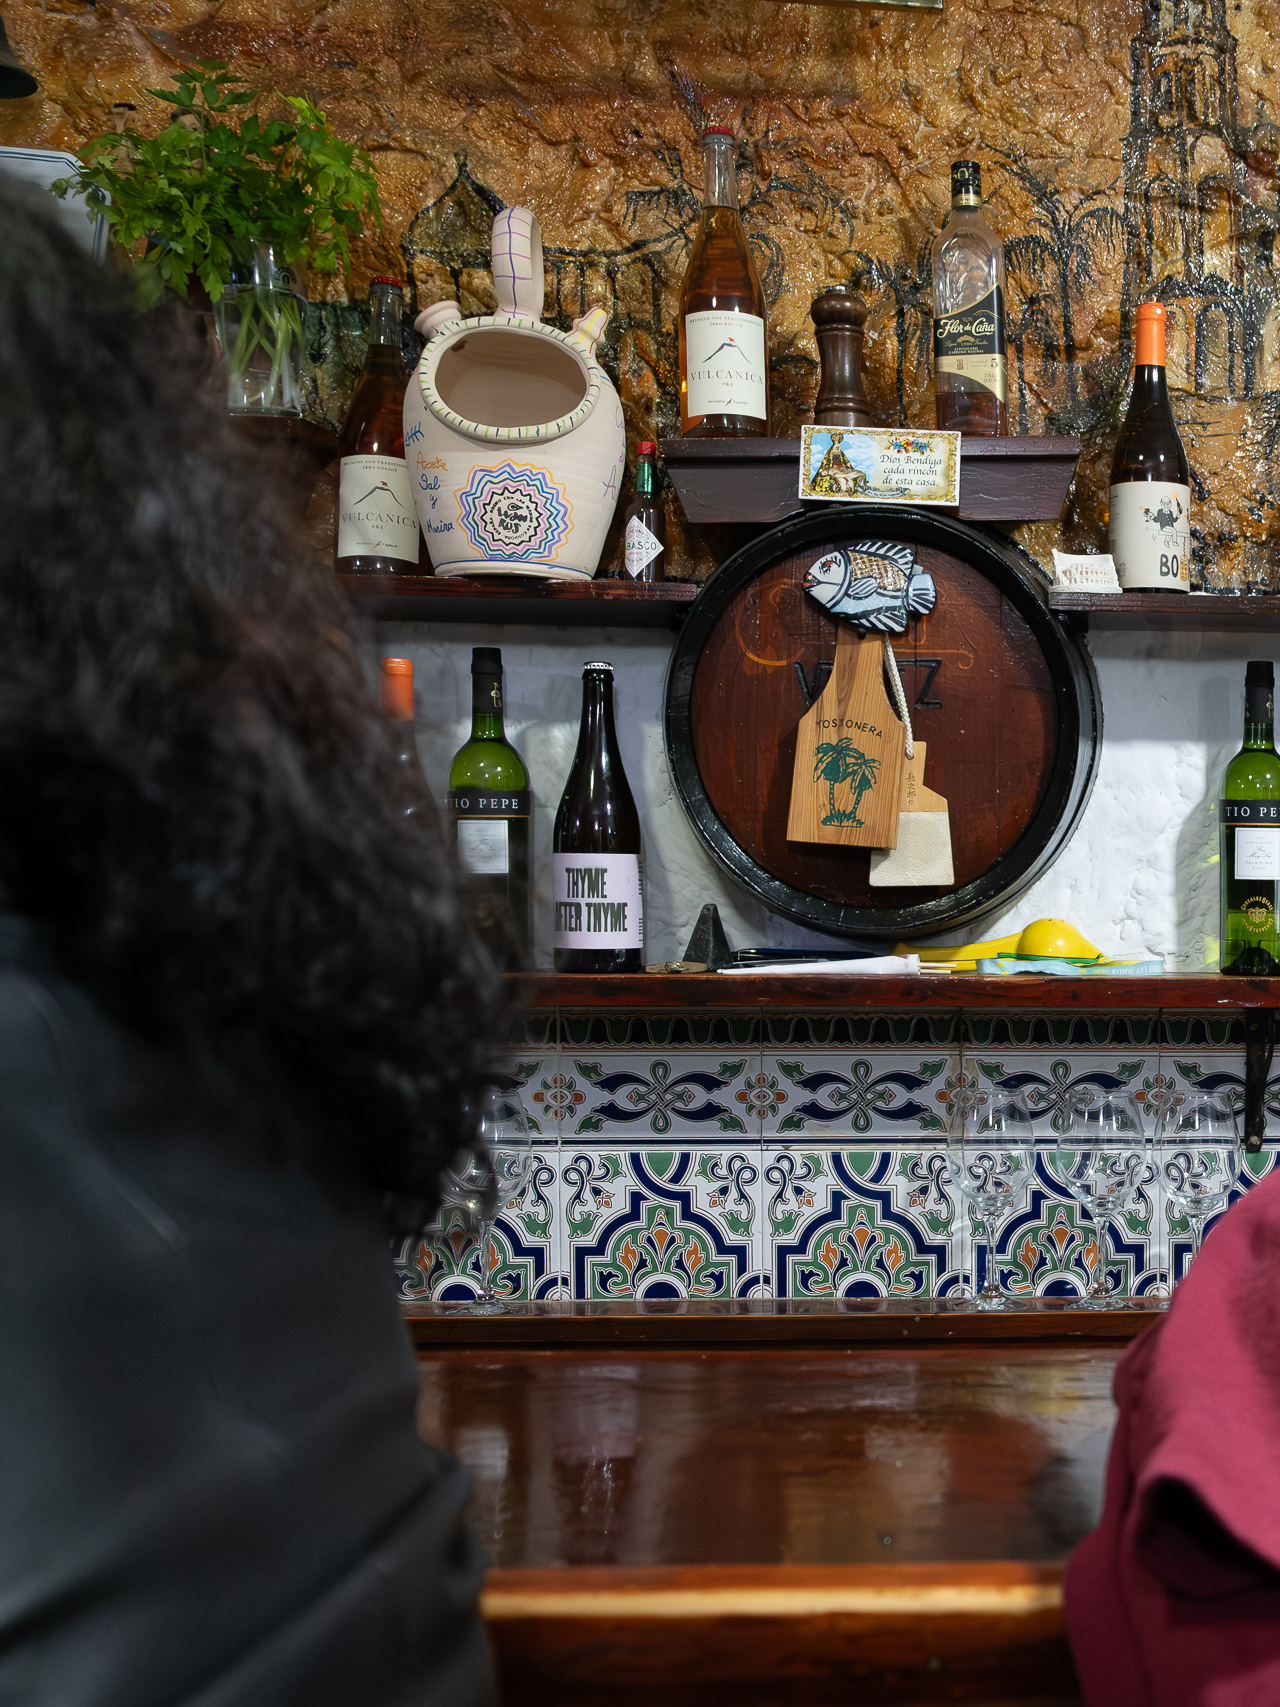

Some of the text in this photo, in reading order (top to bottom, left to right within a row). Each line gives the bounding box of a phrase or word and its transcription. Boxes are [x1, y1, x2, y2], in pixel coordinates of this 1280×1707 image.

[936, 317, 995, 338] Flor de Caña
[691, 370, 763, 384] VULCANICA
[880, 455, 942, 469] Dios Bendiga
[883, 466, 905, 475] cada
[882, 475, 938, 487] de esta casa.
[342, 512, 417, 528] VULCANICA
[626, 541, 657, 551] BASCO
[816, 718, 882, 738] TOSTONERA
[479, 798, 519, 809] PEPE
[1226, 806, 1250, 817] TIO
[565, 867, 607, 898] THYME
[585, 902, 628, 932] THYME
